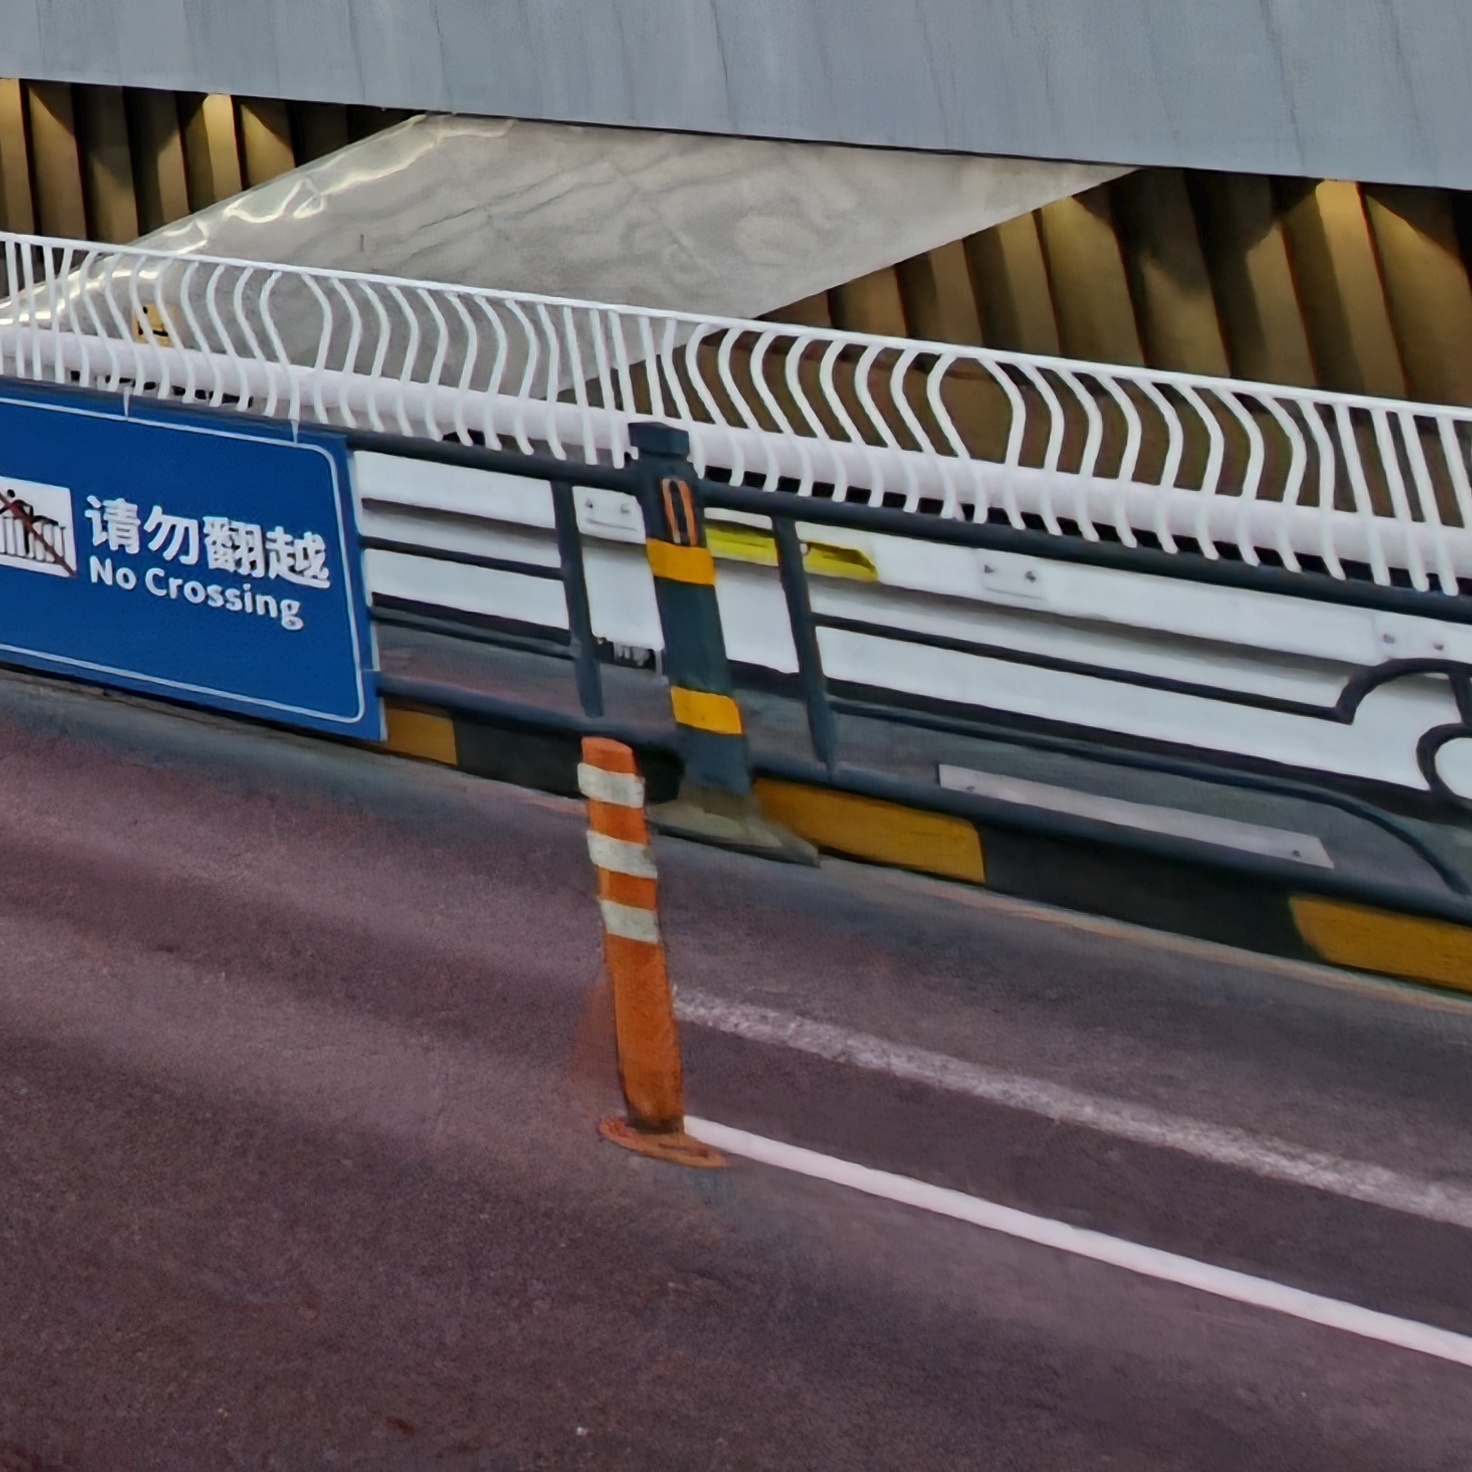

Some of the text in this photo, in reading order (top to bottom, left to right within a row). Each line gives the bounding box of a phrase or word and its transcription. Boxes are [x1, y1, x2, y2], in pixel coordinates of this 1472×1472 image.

[84, 495, 332, 589] 请勿翻越
[88, 555, 305, 631] No Crossing
